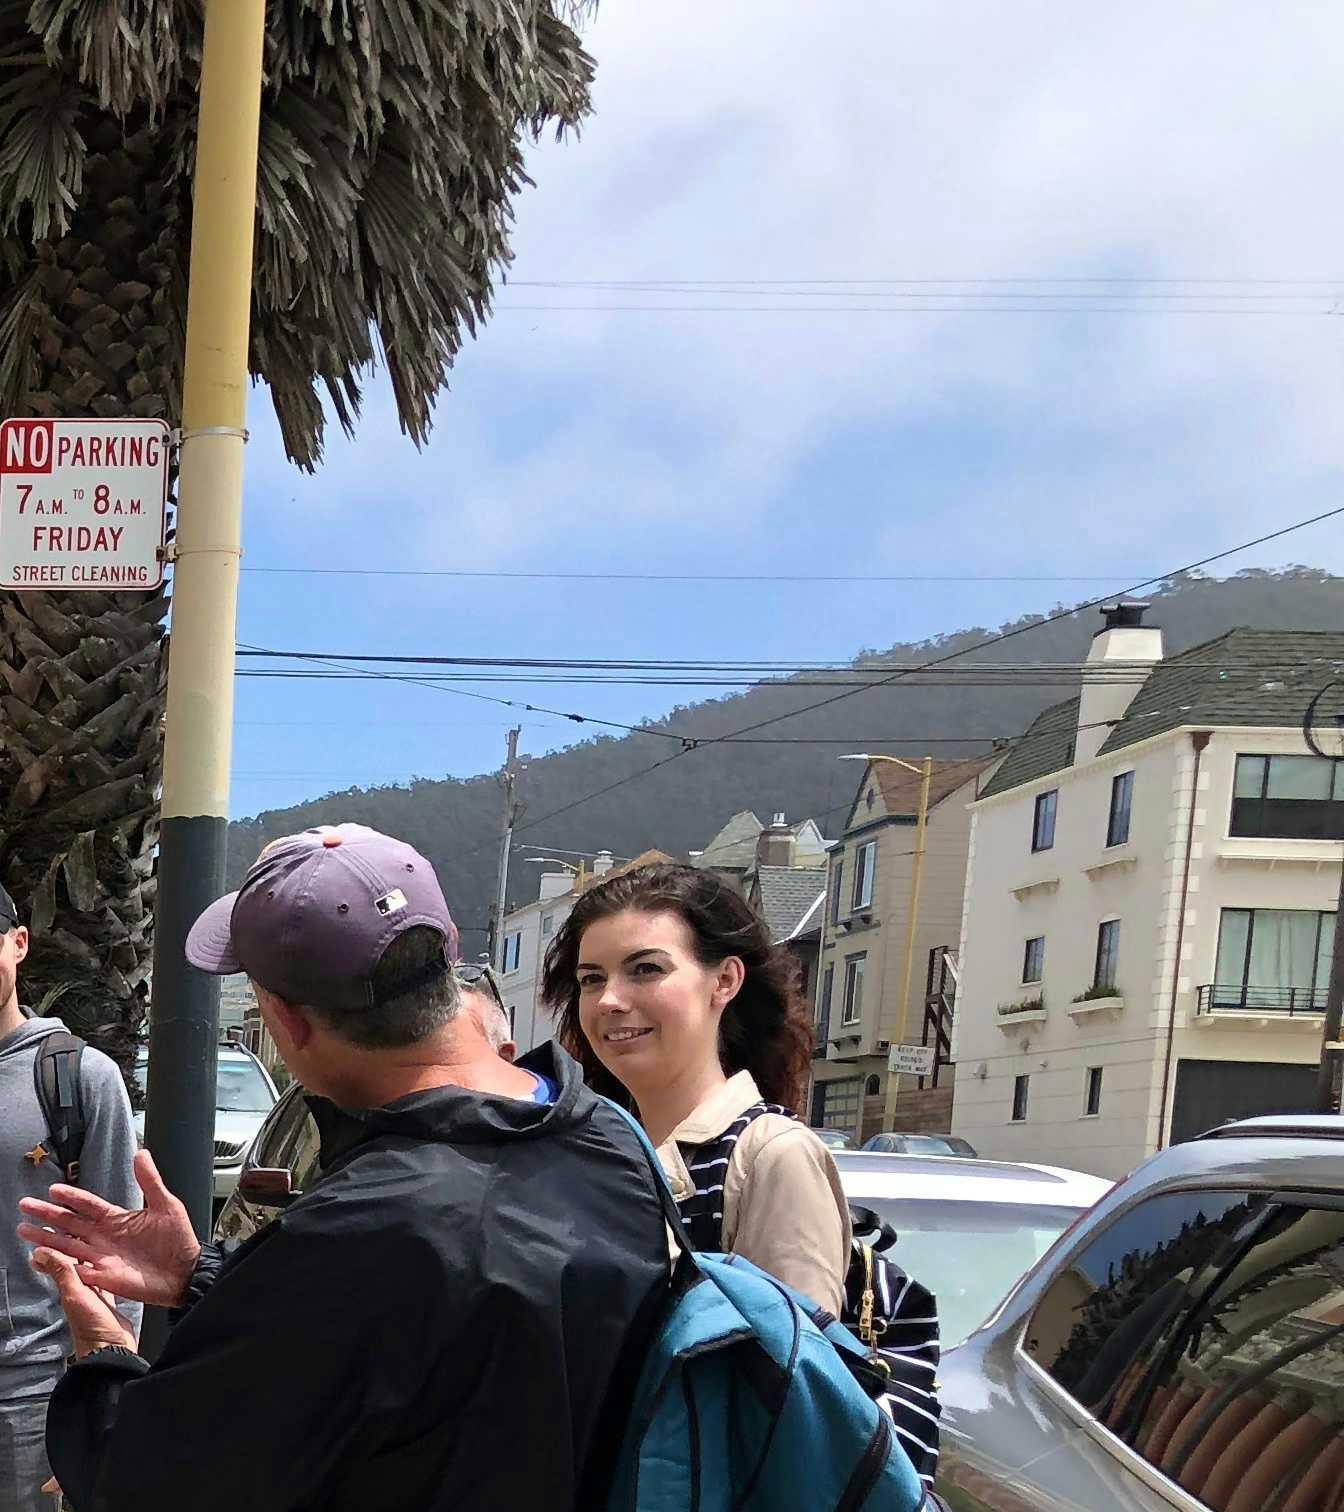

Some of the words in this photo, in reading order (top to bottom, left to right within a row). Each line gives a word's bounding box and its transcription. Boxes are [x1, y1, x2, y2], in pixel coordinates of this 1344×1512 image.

[6, 426, 49, 467] NO
[58, 436, 159, 467] PARKING
[16, 484, 33, 514] 7
[35, 499, 68, 515] A.M.
[73, 488, 85, 500] TO
[93, 484, 110, 515] 8
[114, 499, 147, 515] A.M.
[33, 526, 125, 551] FRIDAY
[12, 565, 66, 581] STREET
[71, 565, 148, 582] CLEANING
